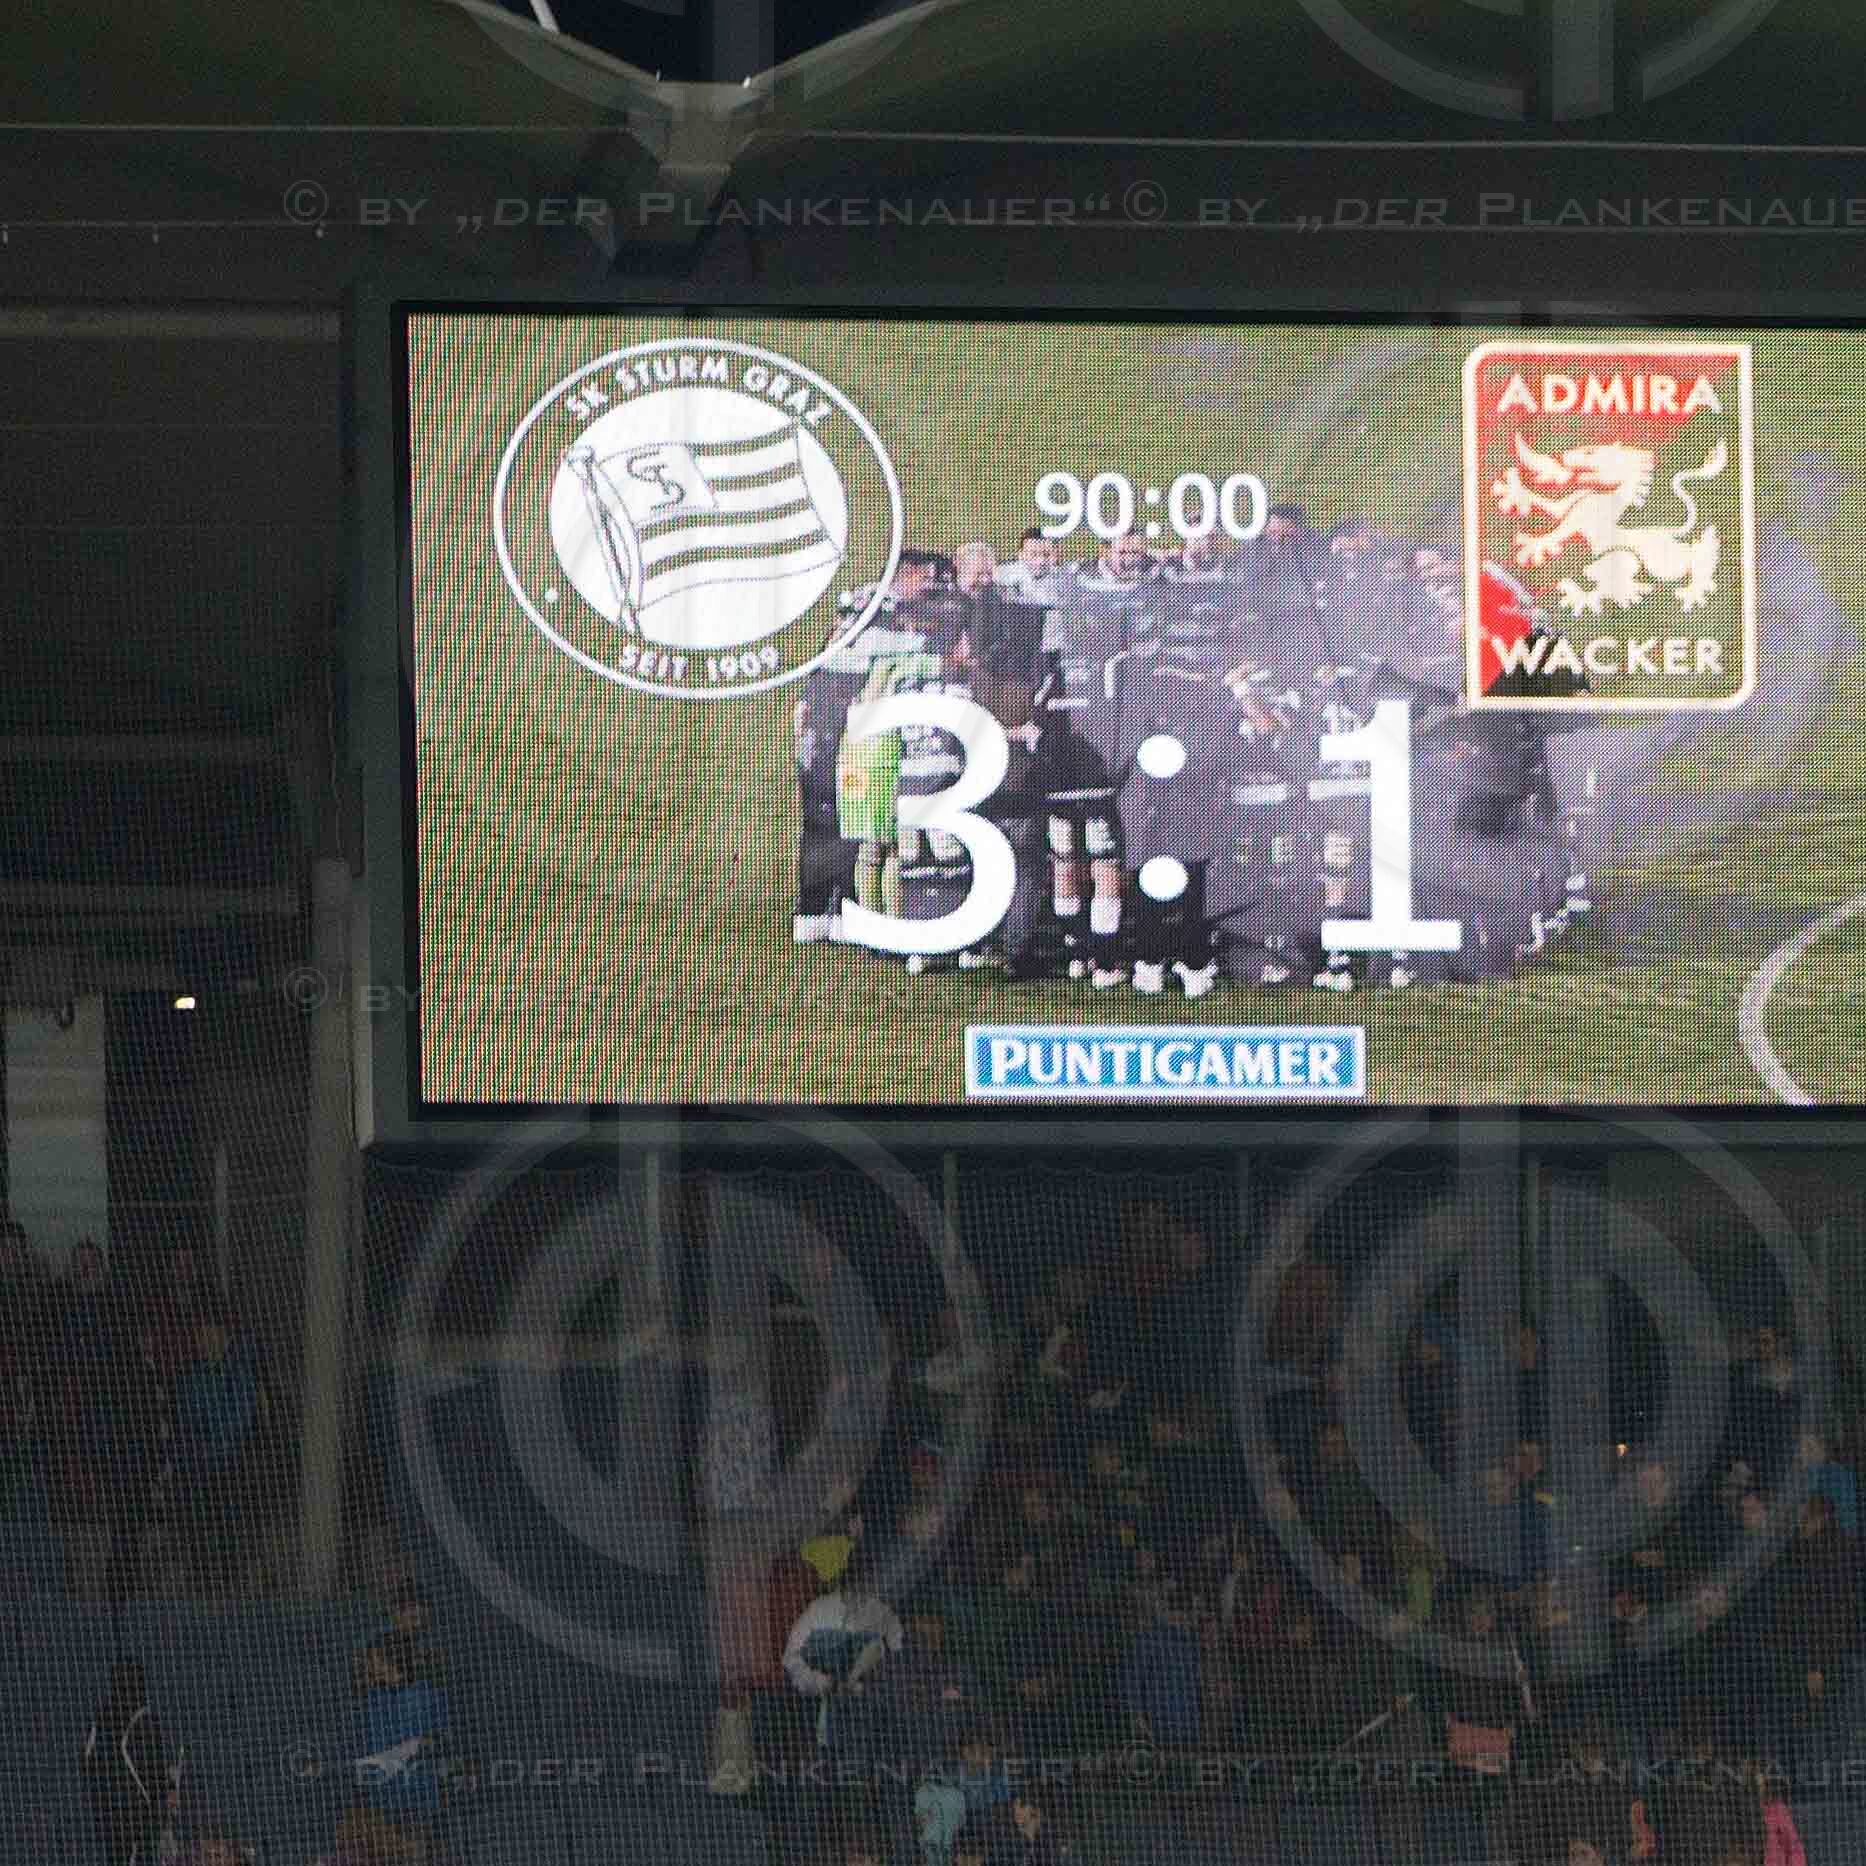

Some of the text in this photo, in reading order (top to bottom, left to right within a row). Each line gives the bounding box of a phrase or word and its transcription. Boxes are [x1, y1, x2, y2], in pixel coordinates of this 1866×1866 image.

[566, 357, 833, 426] SK STURM GRAZ
[1498, 374, 1724, 415] ADMIRA
[1035, 472, 1268, 540] 90:00
[622, 646, 781, 681] SEIT 1909
[1492, 636, 1725, 679] WACKER
[841, 692, 1016, 954] 3
[1318, 700, 1462, 951] 1
[991, 1038, 1342, 1085] PUNTIGAMER
